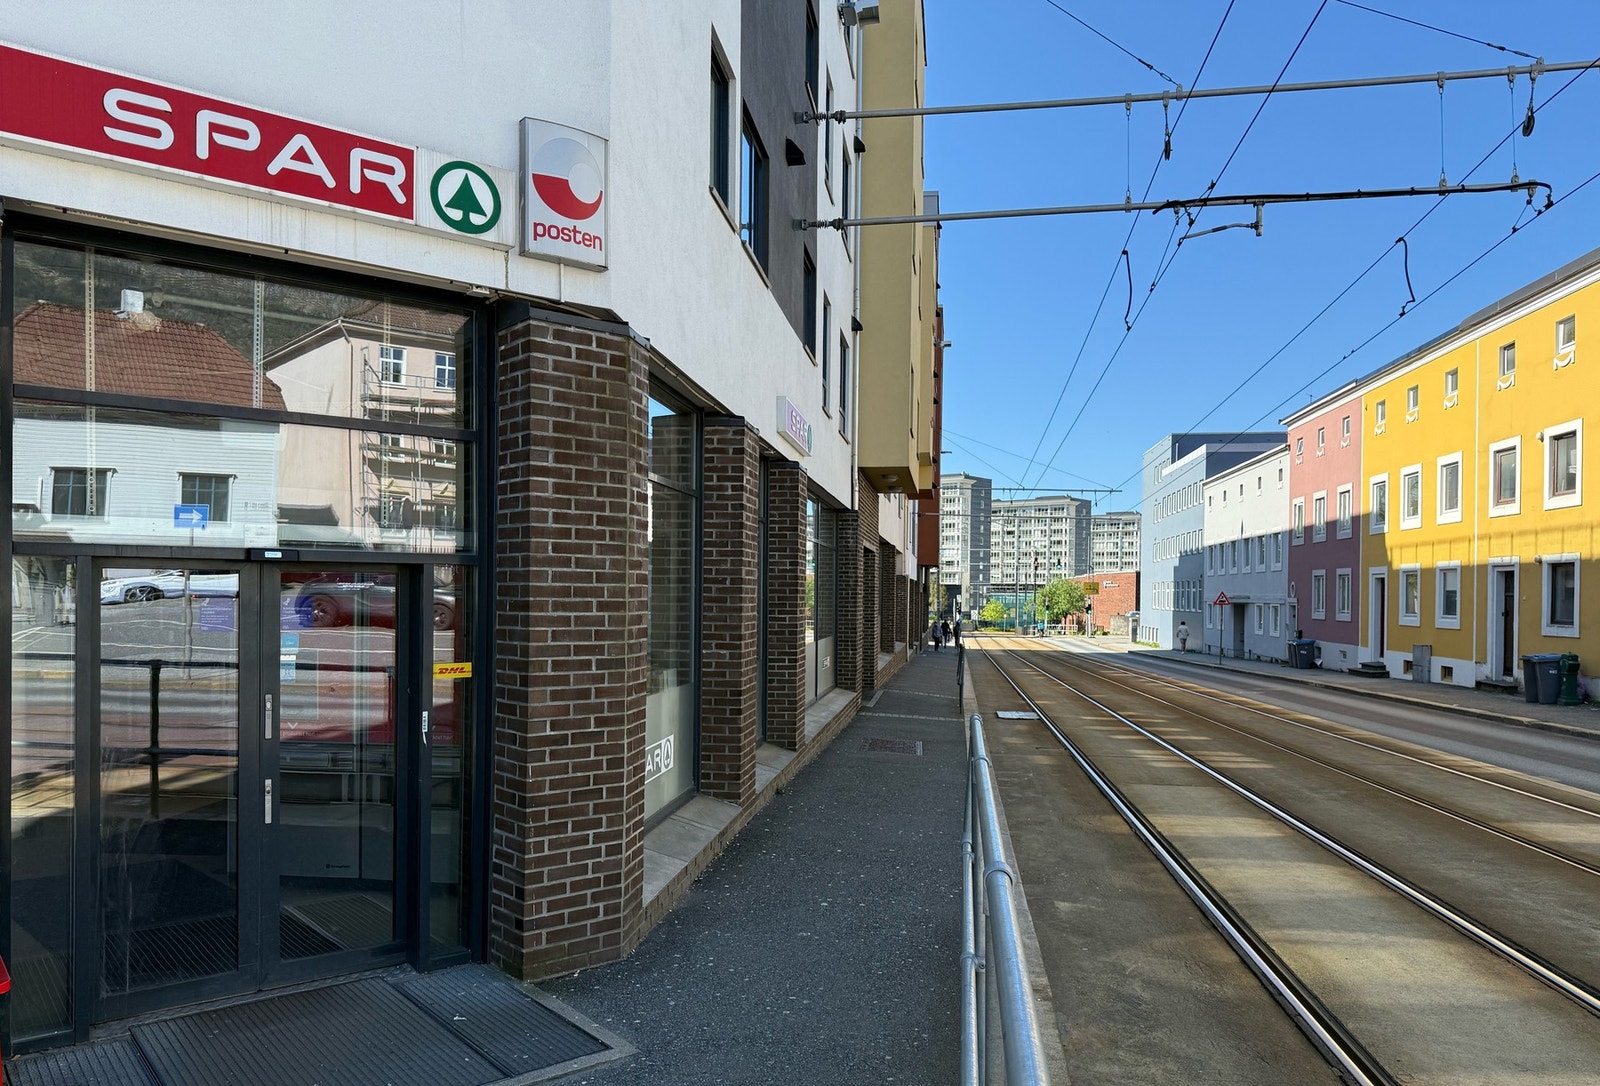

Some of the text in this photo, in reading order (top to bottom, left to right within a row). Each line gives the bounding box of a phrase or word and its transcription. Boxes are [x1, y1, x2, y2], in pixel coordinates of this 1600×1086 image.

[102, 87, 406, 205] SPAR
[533, 221, 603, 251] posten
[438, 665, 466, 675] DHL
